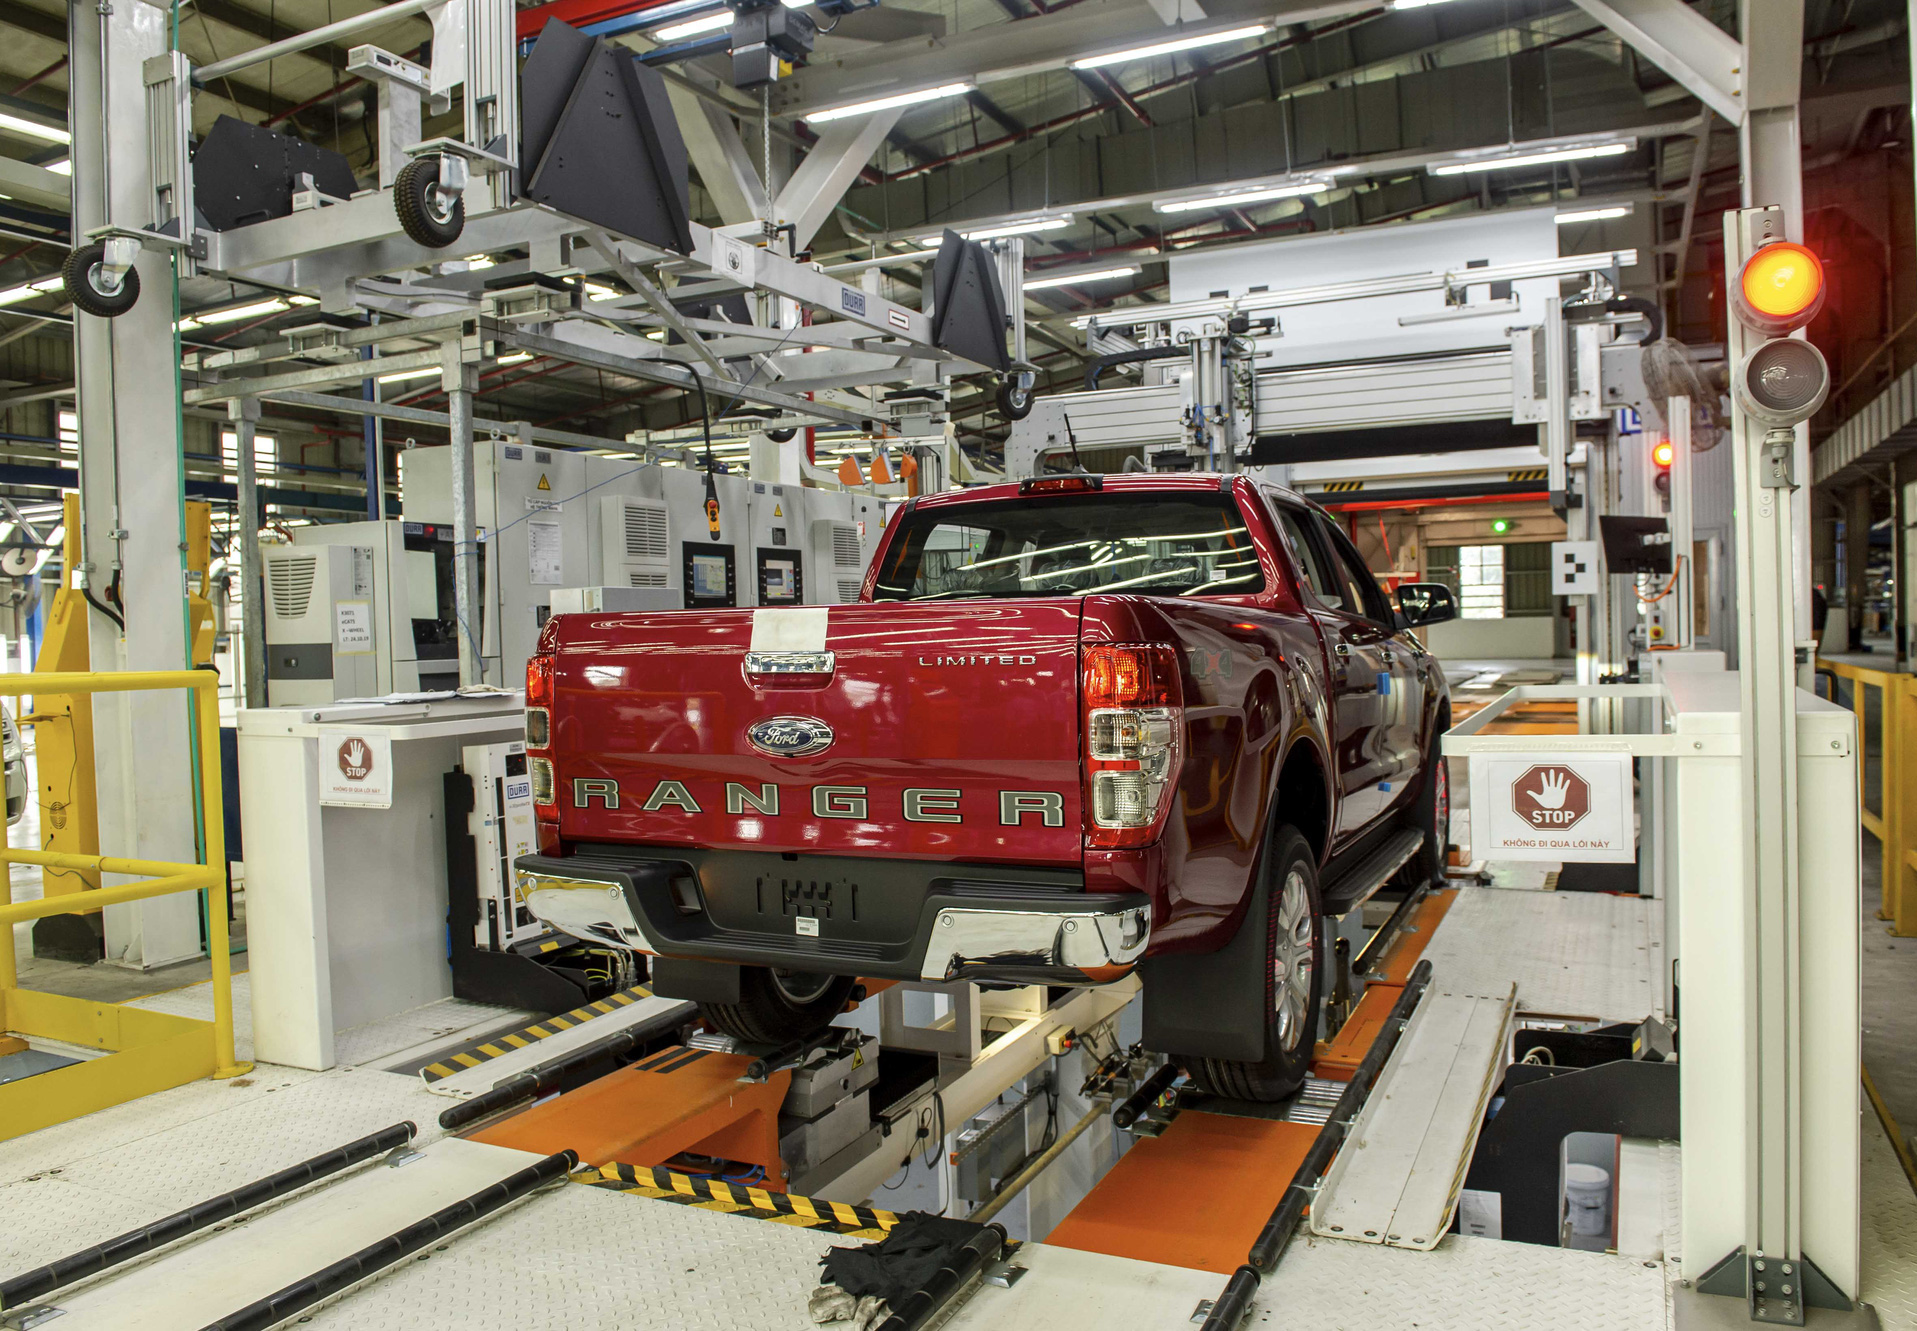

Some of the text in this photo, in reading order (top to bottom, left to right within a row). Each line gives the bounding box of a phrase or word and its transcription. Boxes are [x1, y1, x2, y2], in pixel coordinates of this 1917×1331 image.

[919, 655, 1037, 666] LIMITED
[764, 726, 801, 745] Ford
[346, 767, 367, 777] STOP
[572, 777, 1065, 828] RANGER
[1532, 810, 1576, 824] STOP
[1503, 838, 1536, 848] KHÔNG
[1539, 840, 1548, 848] ĐI
[1550, 840, 1570, 848] QUA
